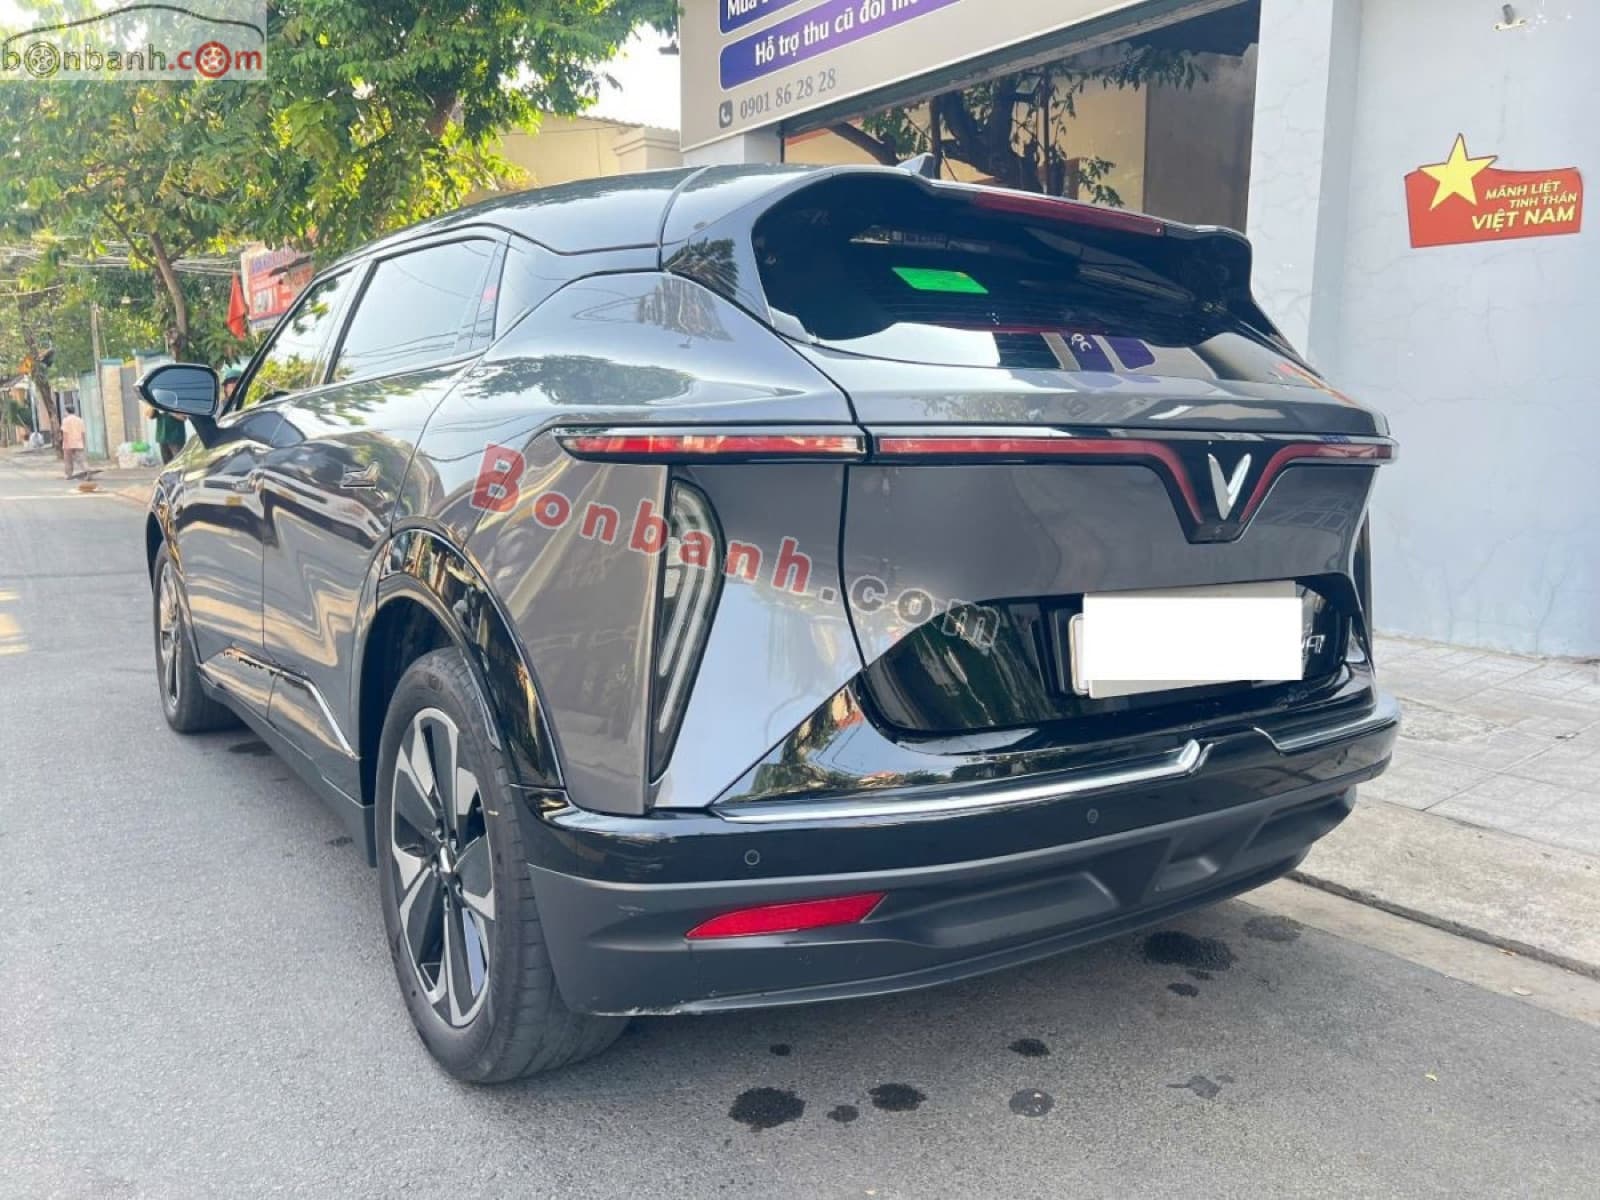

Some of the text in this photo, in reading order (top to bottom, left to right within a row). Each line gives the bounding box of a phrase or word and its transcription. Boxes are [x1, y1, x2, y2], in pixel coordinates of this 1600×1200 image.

[755, 35, 775, 66] Hỗ
[779, 31, 799, 57] trợ
[803, 20, 829, 46] thu
[834, 7, 853, 33] cũ
[740, 67, 836, 119] 0901 86 28 28
[1471, 205, 1576, 232] VIỆT NAM
[1510, 197, 1538, 209] TINH
